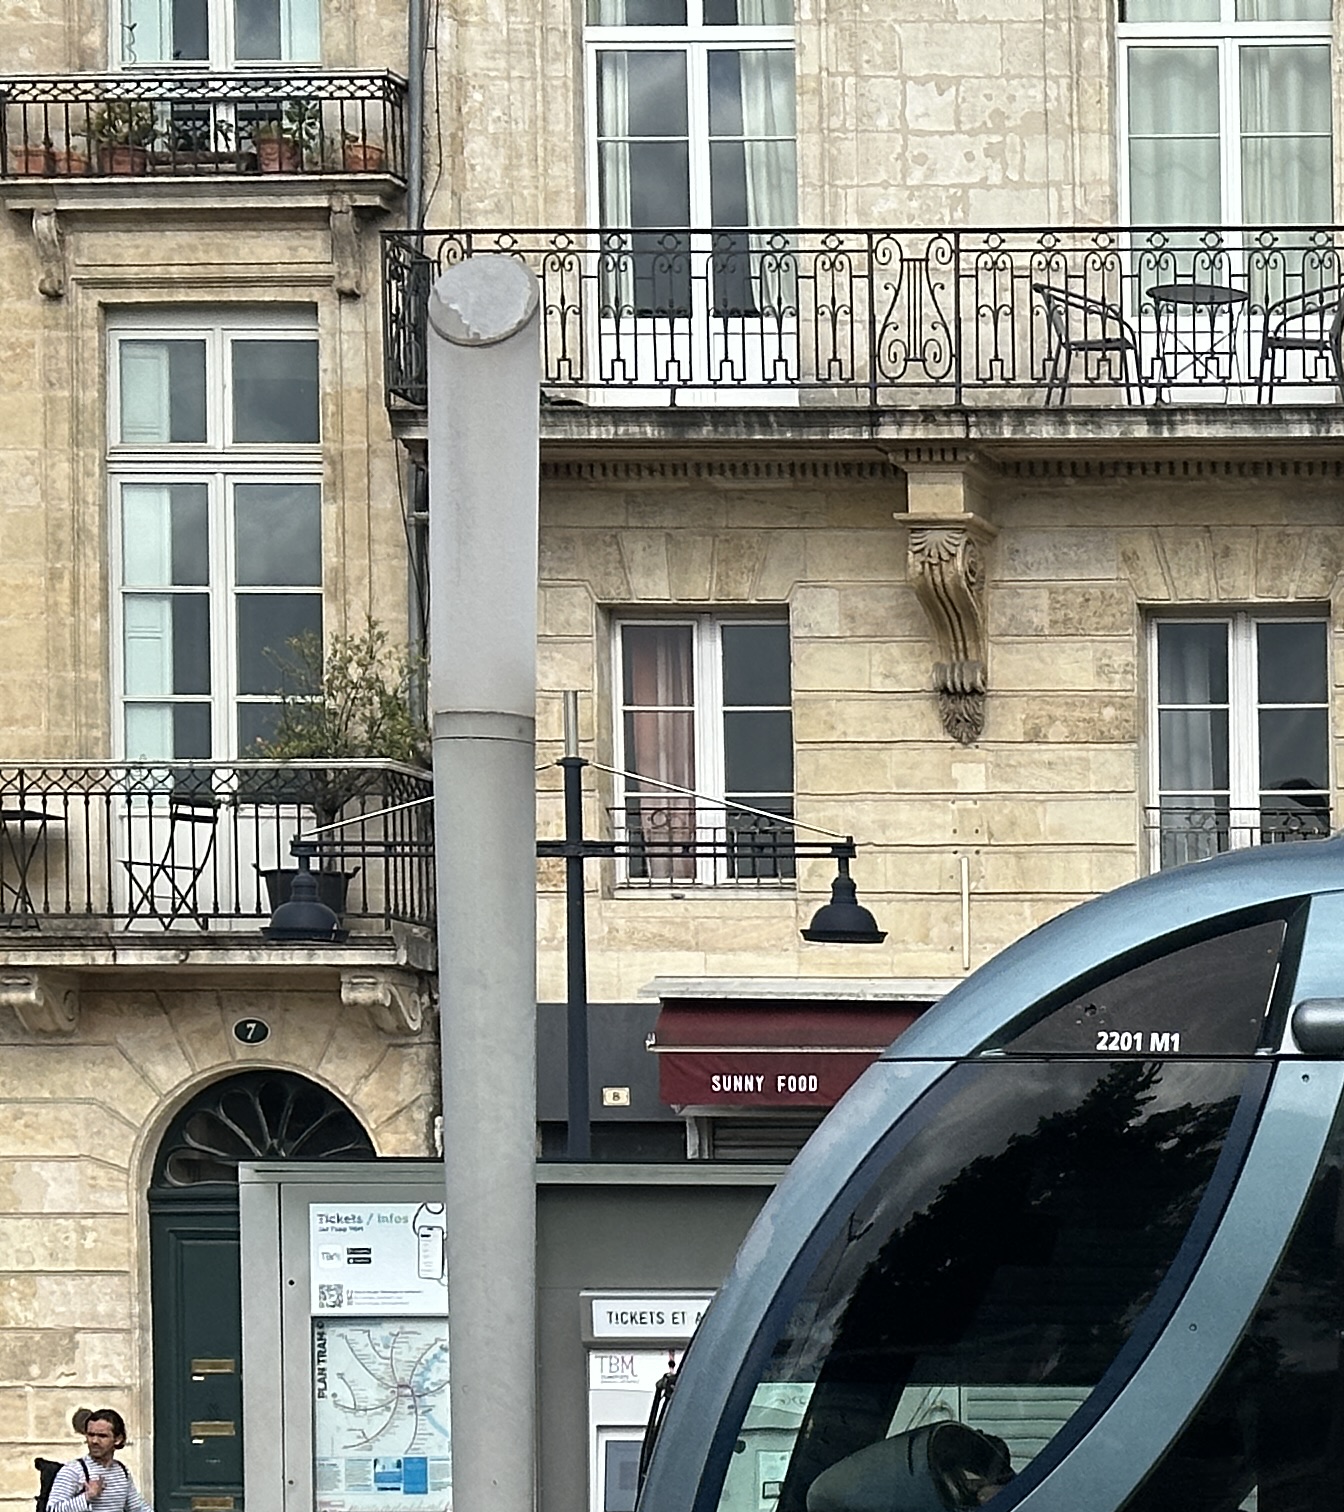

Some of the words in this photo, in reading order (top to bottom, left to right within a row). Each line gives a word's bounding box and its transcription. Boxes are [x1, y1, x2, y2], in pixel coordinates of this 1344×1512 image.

[246, 1023, 257, 1040] 7
[1096, 1031, 1143, 1051] 2201
[1150, 1032, 1180, 1052] M1
[711, 1074, 765, 1092] SUNNY
[777, 1074, 818, 1093] FOOD
[317, 1212, 364, 1225] Tickets
[607, 1311, 665, 1325] TICKETS
[671, 1311, 687, 1325] ET
[316, 1331, 327, 1365] TRAM
[595, 1355, 638, 1377] TBM
[317, 1367, 328, 1399] PLAN
